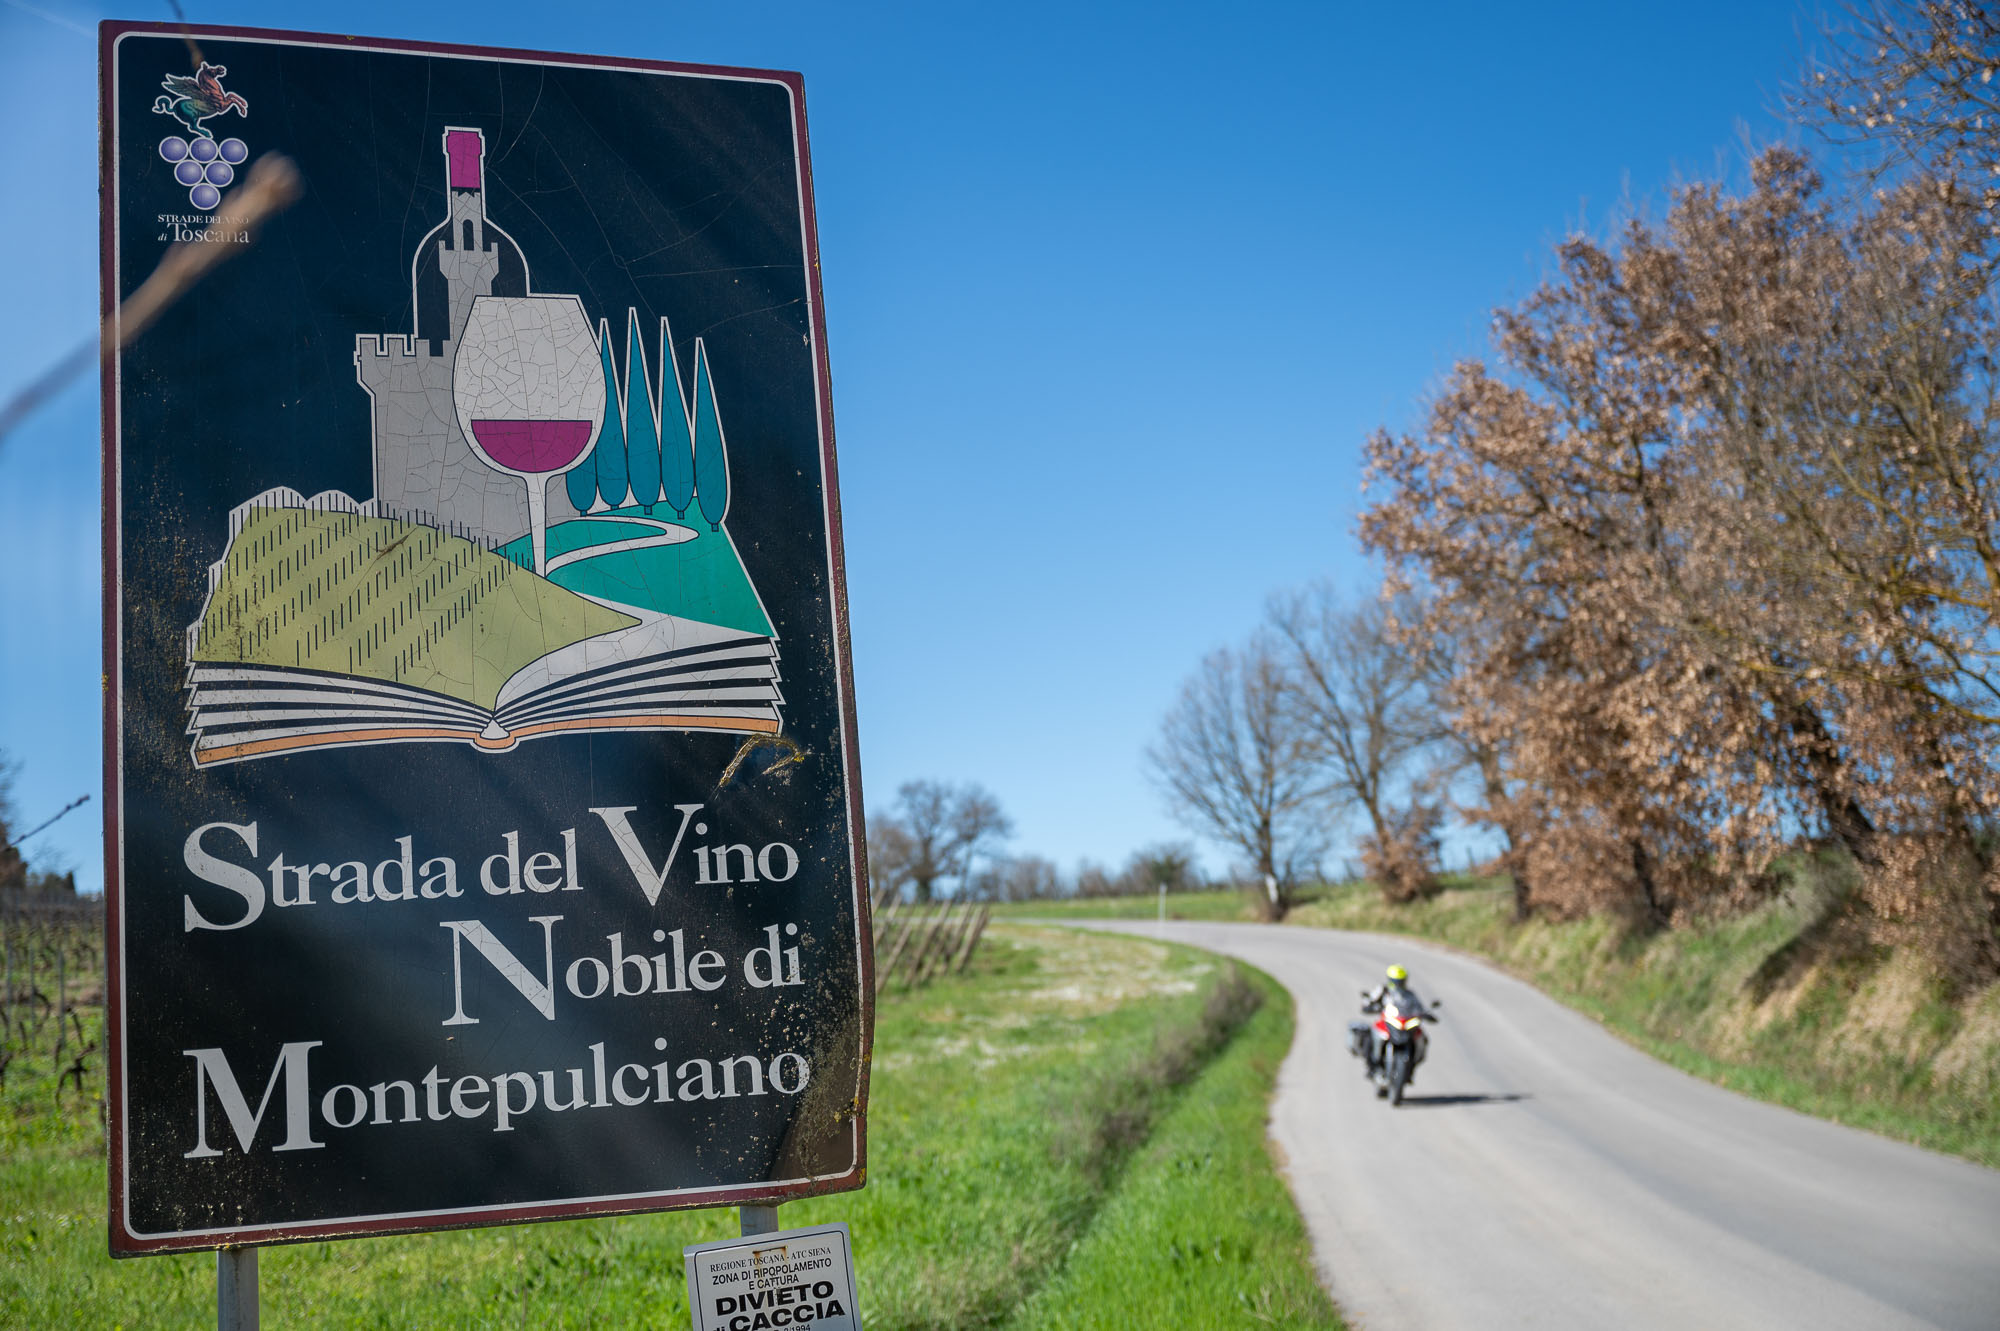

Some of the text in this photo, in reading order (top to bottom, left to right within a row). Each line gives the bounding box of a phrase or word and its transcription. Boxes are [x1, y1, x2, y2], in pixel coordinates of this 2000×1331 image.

[157, 214, 203, 223] STRADE
[205, 215, 220, 224] DEL
[157, 222, 249, 243] di Toscana
[184, 804, 799, 931] Strada del Vino
[440, 915, 805, 1025] Nobile di
[184, 1038, 809, 1158] Montepulciano
[710, 1259, 746, 1273] REGIONE
[748, 1253, 785, 1267] TOSCANA
[791, 1250, 807, 1260] ATC
[808, 1247, 831, 1258] SIENA
[712, 1258, 832, 1285] ZONA DI RIPOPOLAMENTO
[749, 1274, 799, 1290] E CATTURA
[715, 1280, 834, 1316] DIVIETO
[729, 1300, 845, 1331] CACCIA
